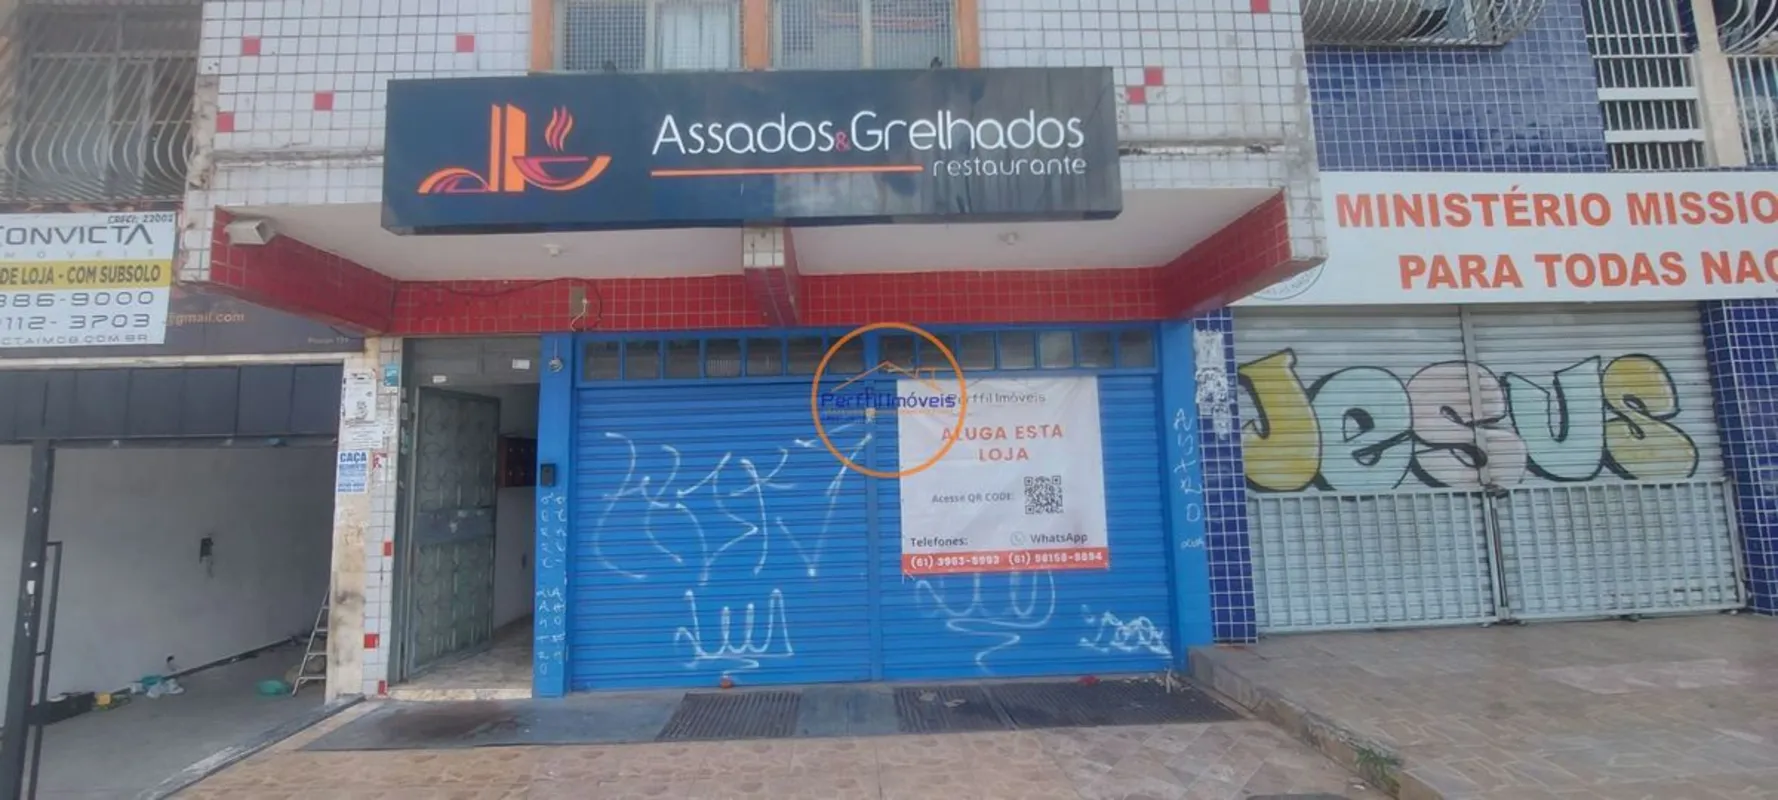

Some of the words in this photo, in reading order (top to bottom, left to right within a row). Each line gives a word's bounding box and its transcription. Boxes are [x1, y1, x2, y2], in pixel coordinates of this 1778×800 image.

[933, 154, 1087, 178] restaurante
[1335, 184, 1612, 228] MINISTÉRIO
[1627, 190, 1778, 227] MISSIO
[21, 267, 54, 284] LOJA
[66, 266, 97, 284] COM
[100, 264, 161, 283] SUBSOLO
[1398, 253, 1523, 290] PARA
[1534, 250, 1688, 288] TODAS
[1237, 348, 1700, 492] Jesus
[942, 426, 1007, 441] AUGA
[1015, 424, 1063, 440] ESTA
[340, 451, 367, 464] CAÇA
[978, 447, 1029, 462] LOJA
[932, 493, 965, 503] Acesse
[967, 493, 982, 503] QR
[910, 537, 969, 547] Telefones:
[1030, 532, 1088, 545] WhatsApp
